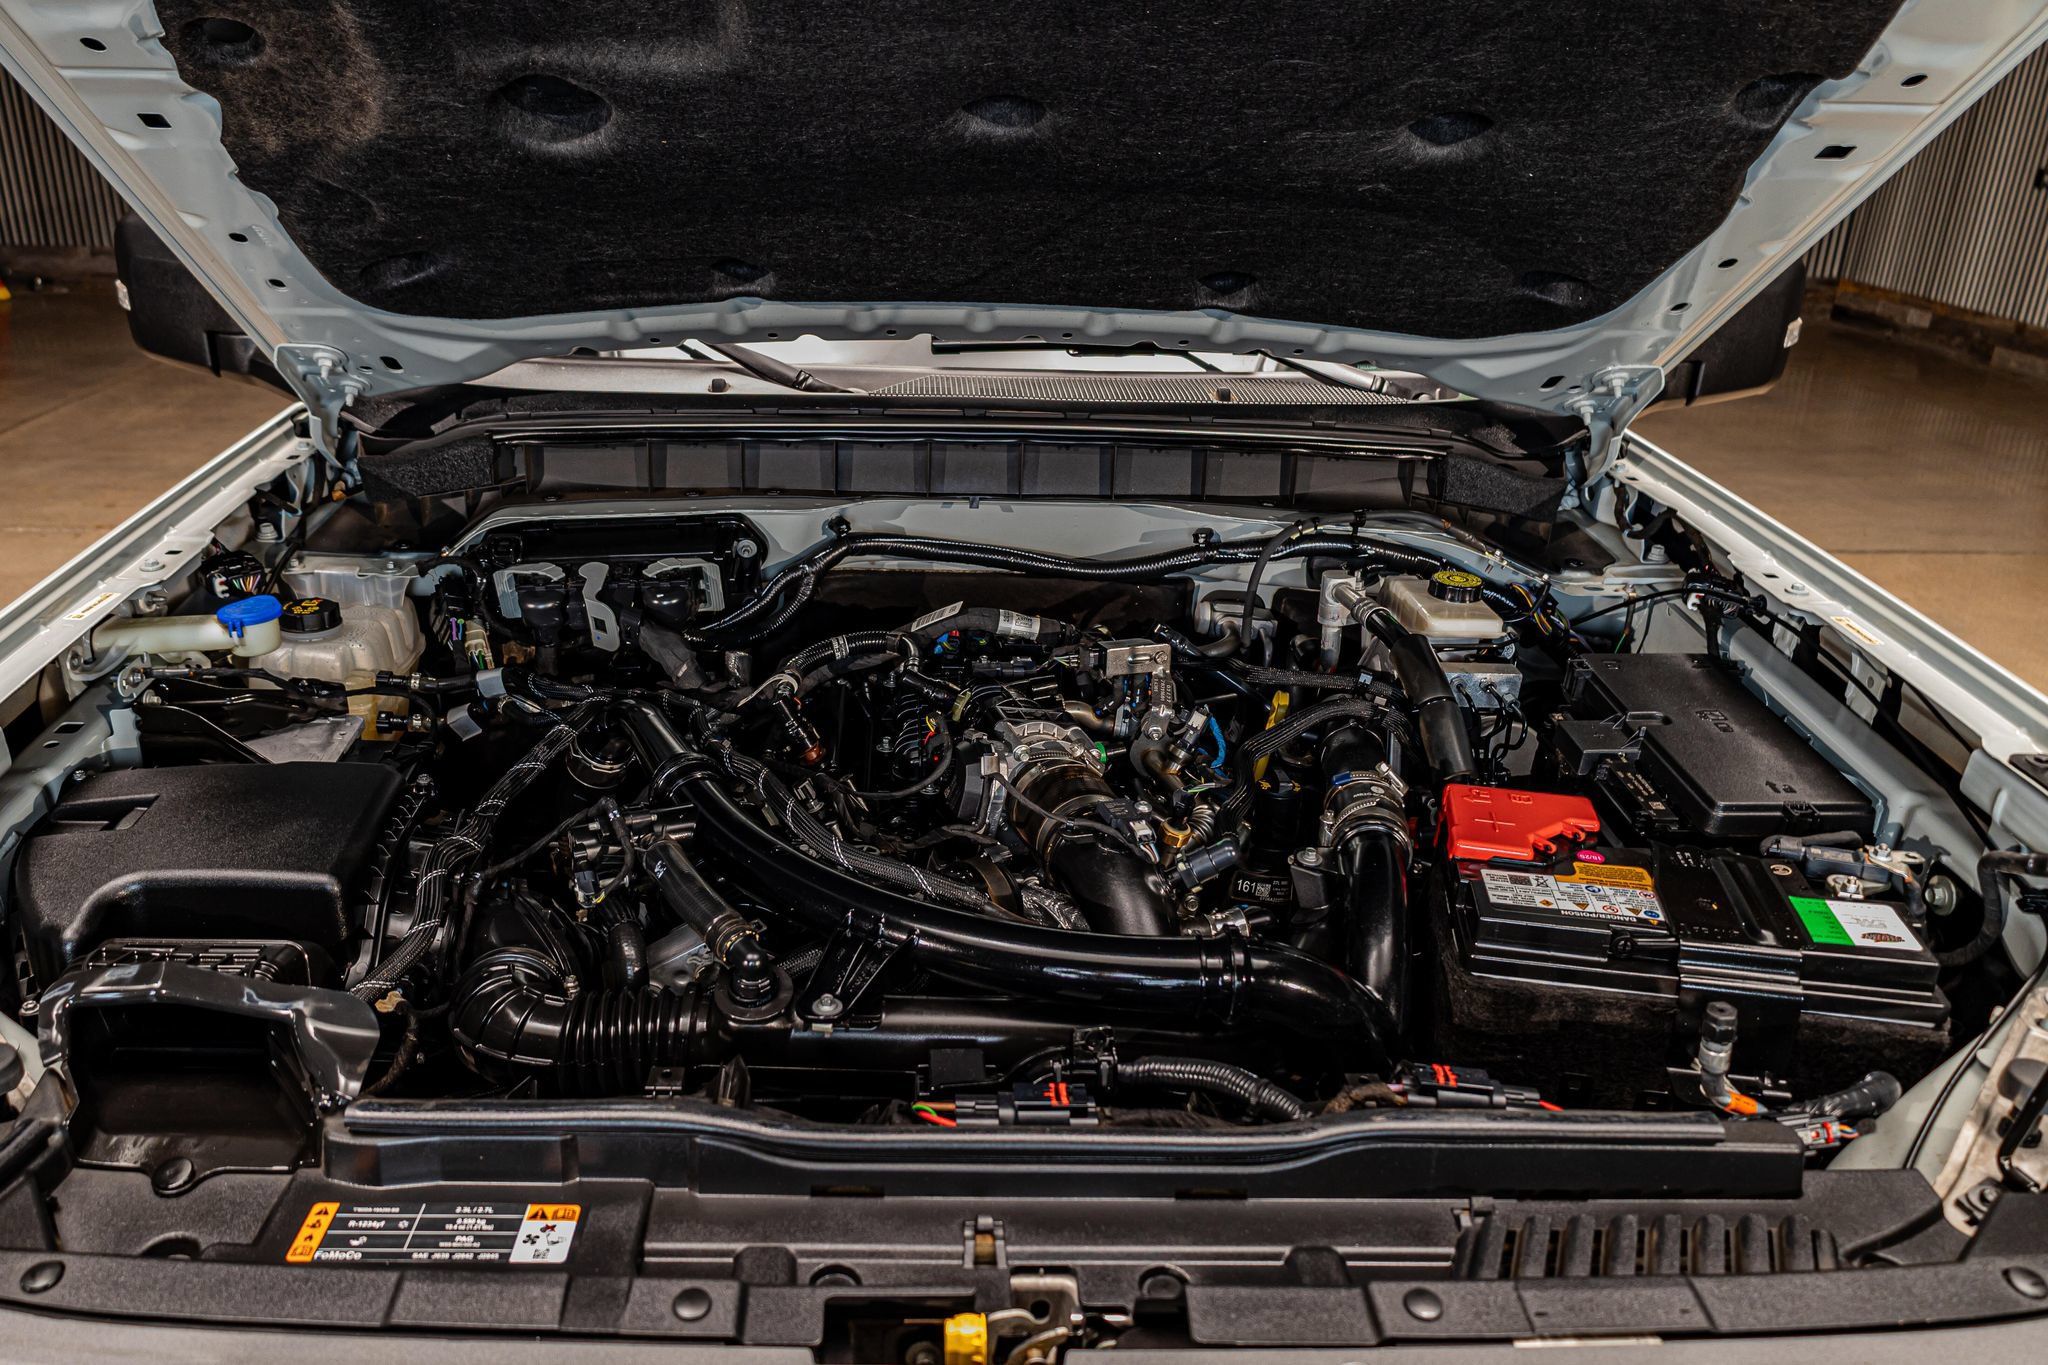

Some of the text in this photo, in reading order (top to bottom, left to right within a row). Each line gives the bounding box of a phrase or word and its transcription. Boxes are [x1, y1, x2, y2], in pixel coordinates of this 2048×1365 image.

[1237, 879, 1256, 893] 161
[1561, 910, 1637, 923] DANGER/POISON
[348, 1219, 386, 1229] R-1234yf
[313, 1250, 363, 1260] FoMoCo
